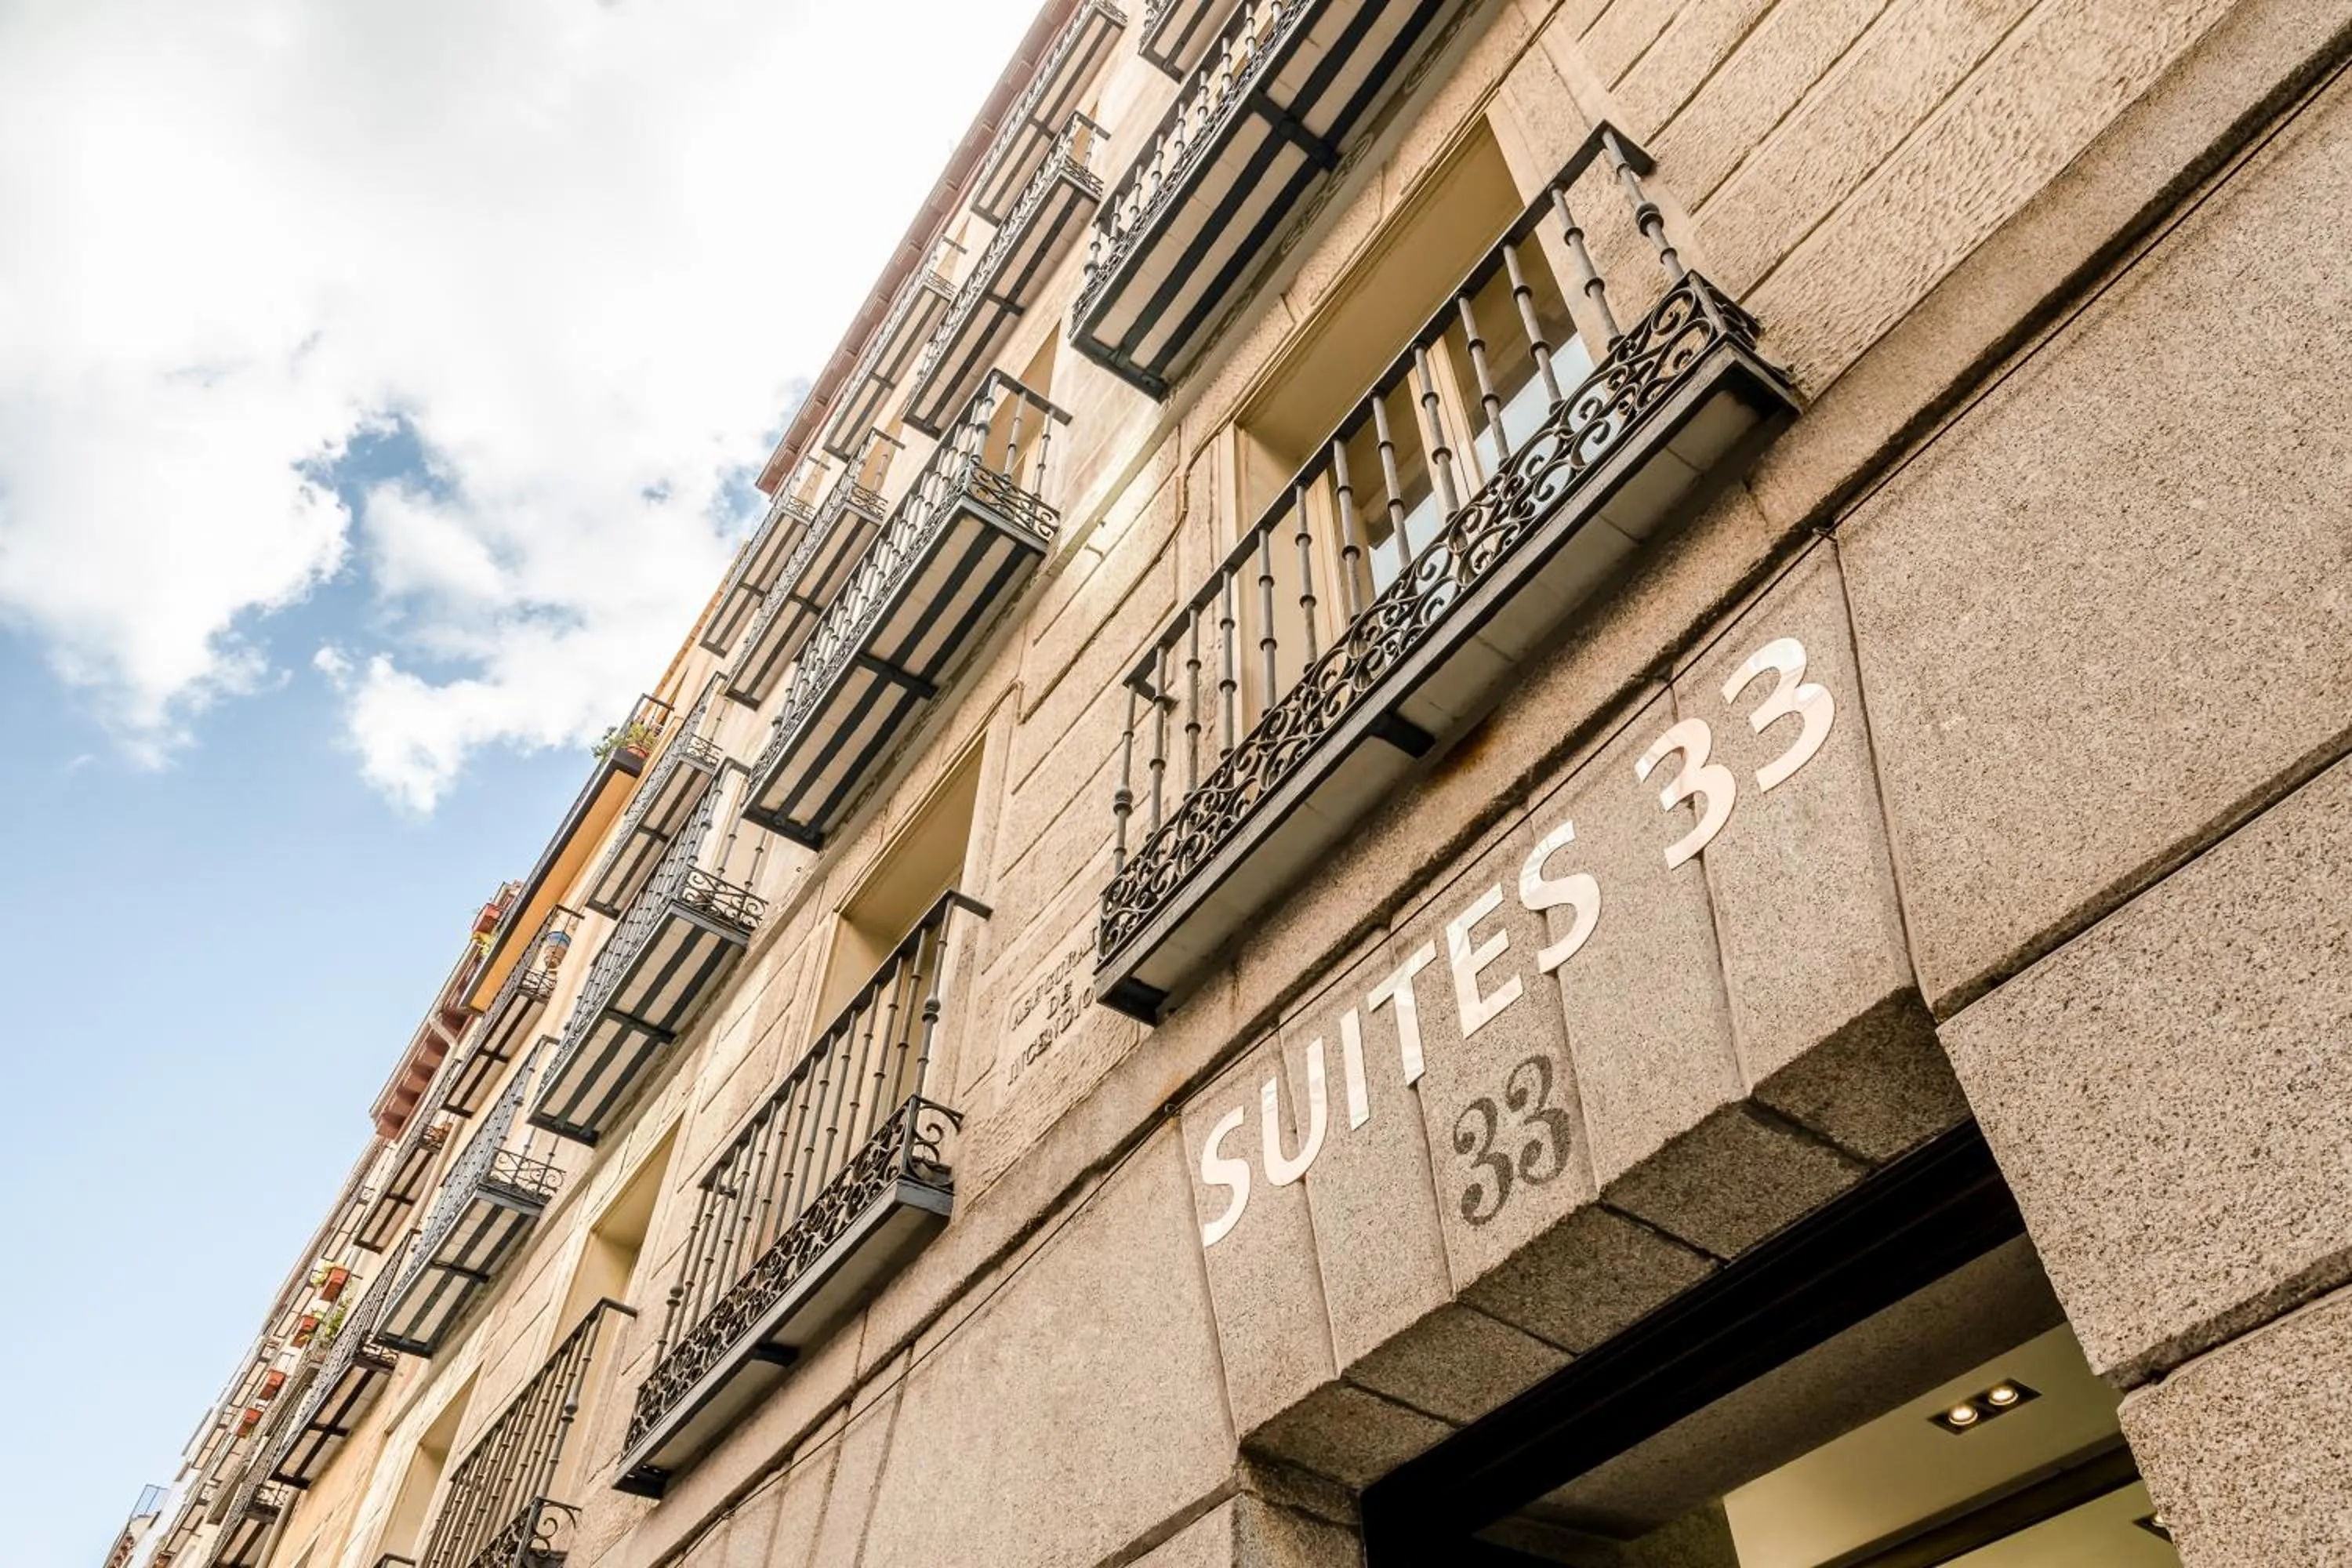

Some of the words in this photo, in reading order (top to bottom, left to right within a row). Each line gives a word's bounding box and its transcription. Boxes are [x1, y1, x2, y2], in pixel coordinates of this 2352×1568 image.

[1046, 979, 1073, 1020] DE
[1200, 818, 1602, 1247] SUITES
[1634, 637, 1836, 870] 33
[1453, 1054, 1571, 1226] 33
